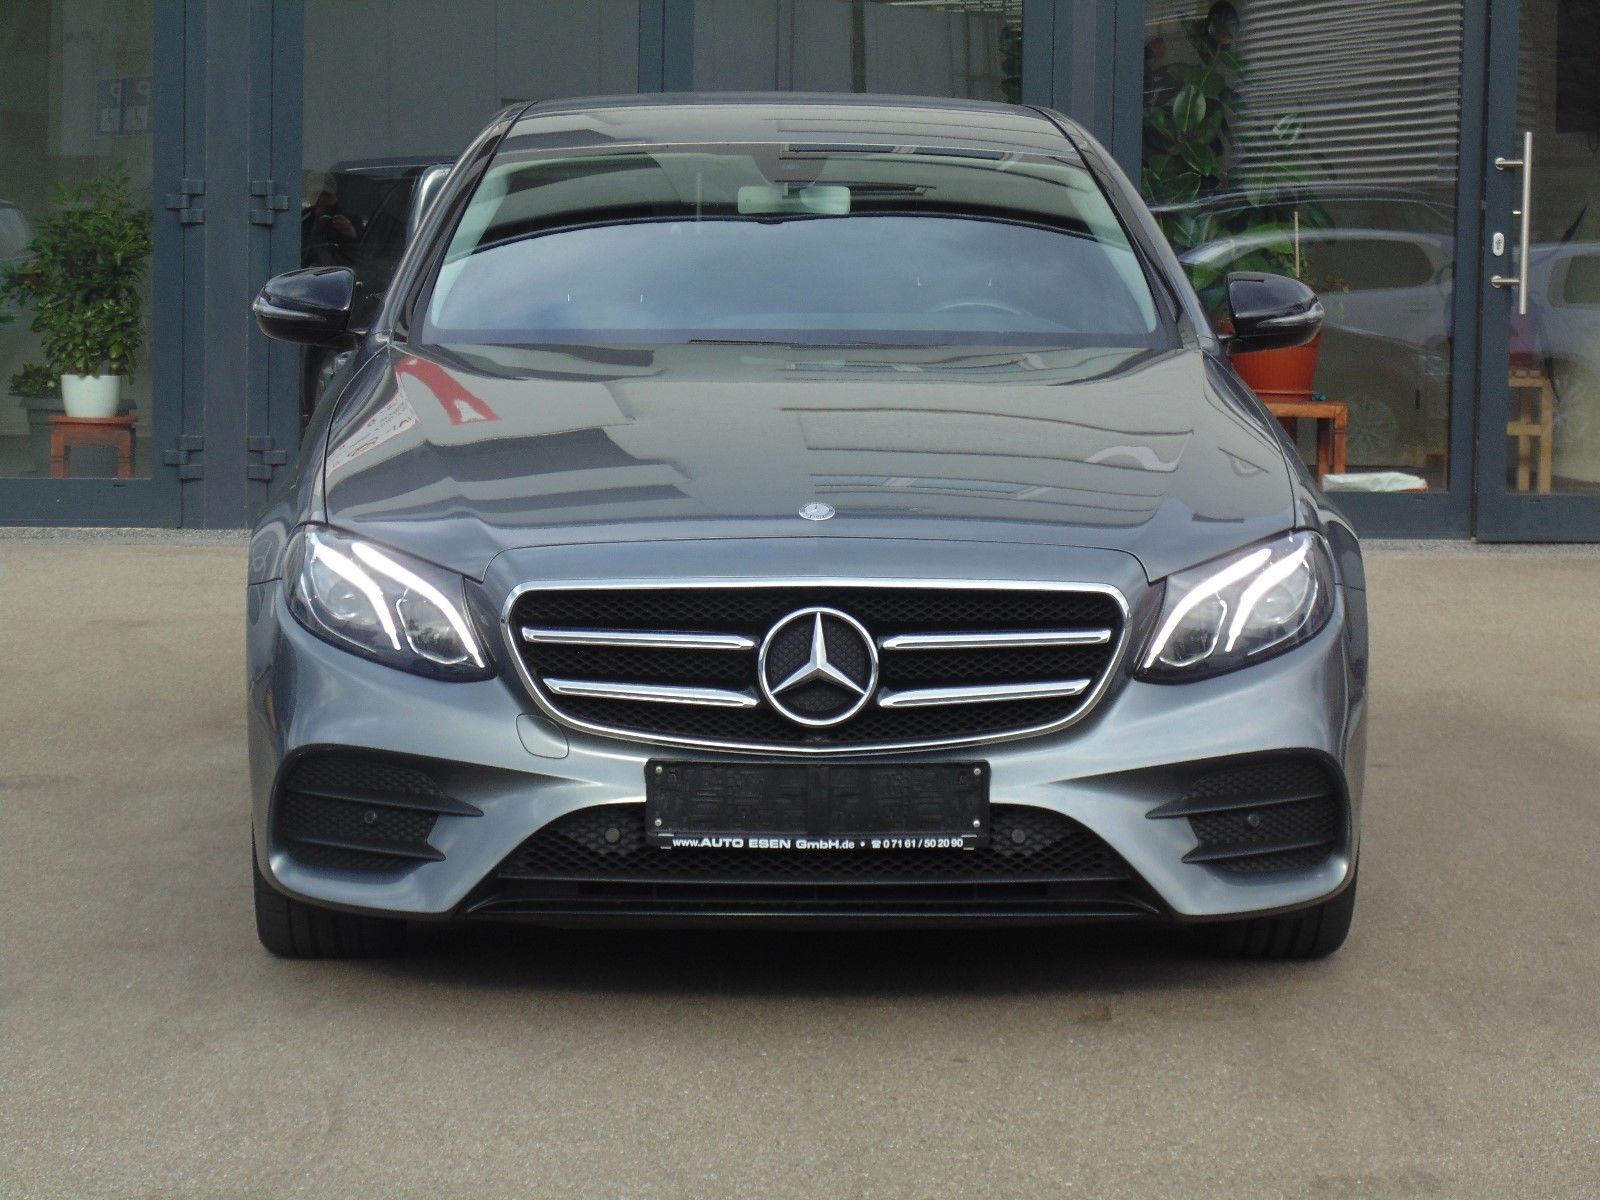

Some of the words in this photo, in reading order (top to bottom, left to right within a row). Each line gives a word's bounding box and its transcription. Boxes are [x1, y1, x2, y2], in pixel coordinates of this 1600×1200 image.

[672, 838, 744, 848] www.AUTO
[748, 838, 791, 849] ESEN
[795, 838, 855, 850] GmbH.de
